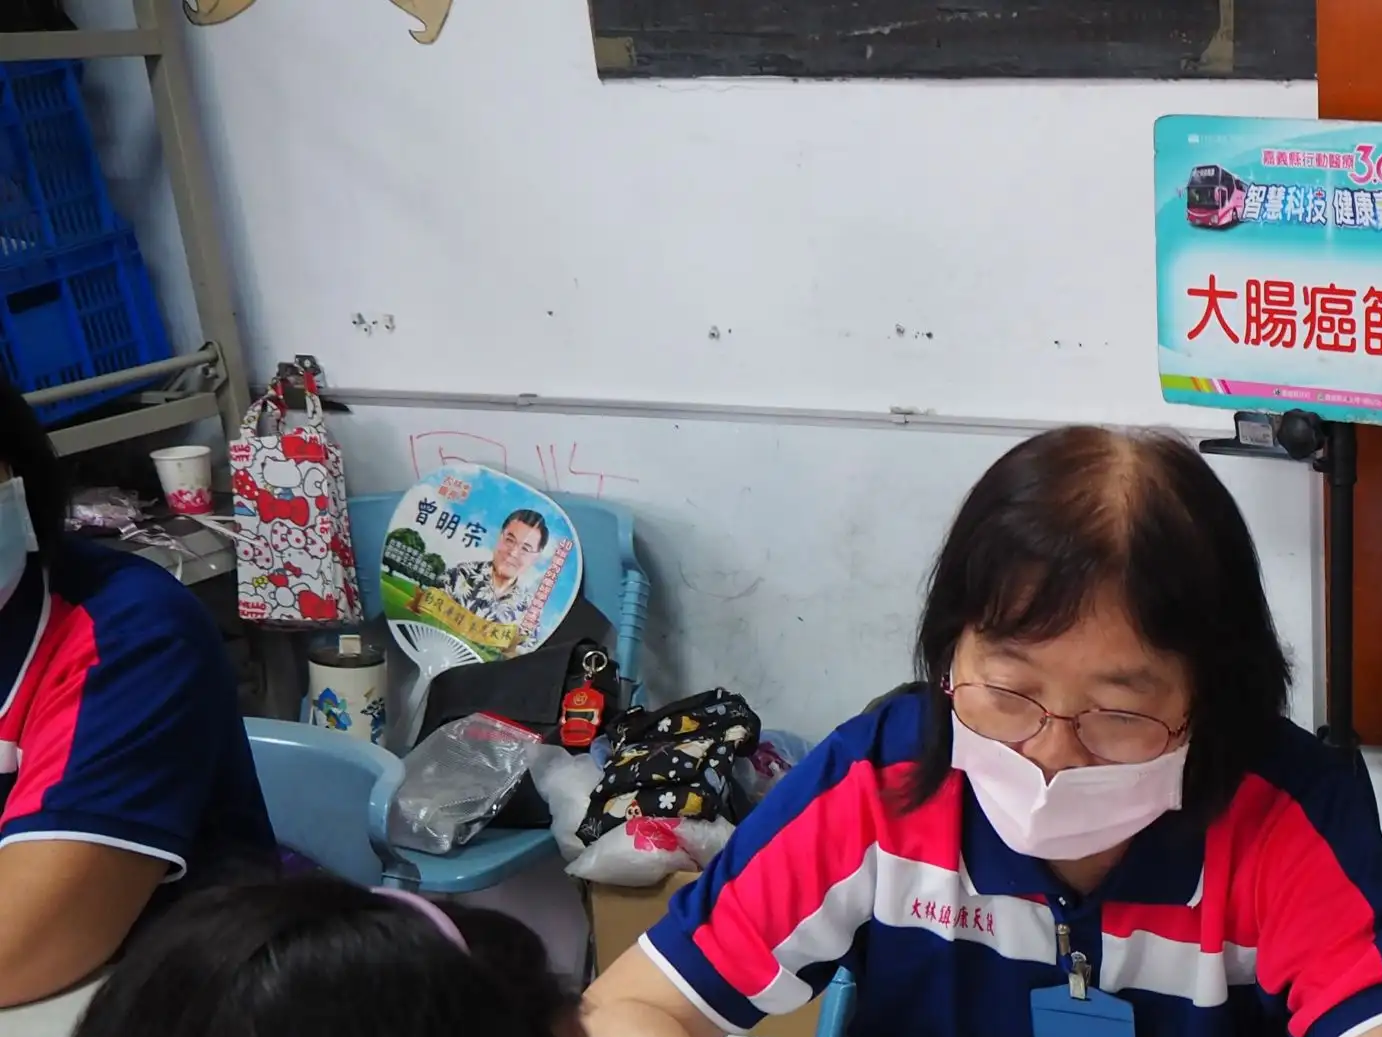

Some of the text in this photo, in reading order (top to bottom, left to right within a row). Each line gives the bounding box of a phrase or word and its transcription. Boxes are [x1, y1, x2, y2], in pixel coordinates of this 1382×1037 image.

[1242, 184, 1328, 226] 智慧科技
[415, 497, 488, 548] 曾明宗
